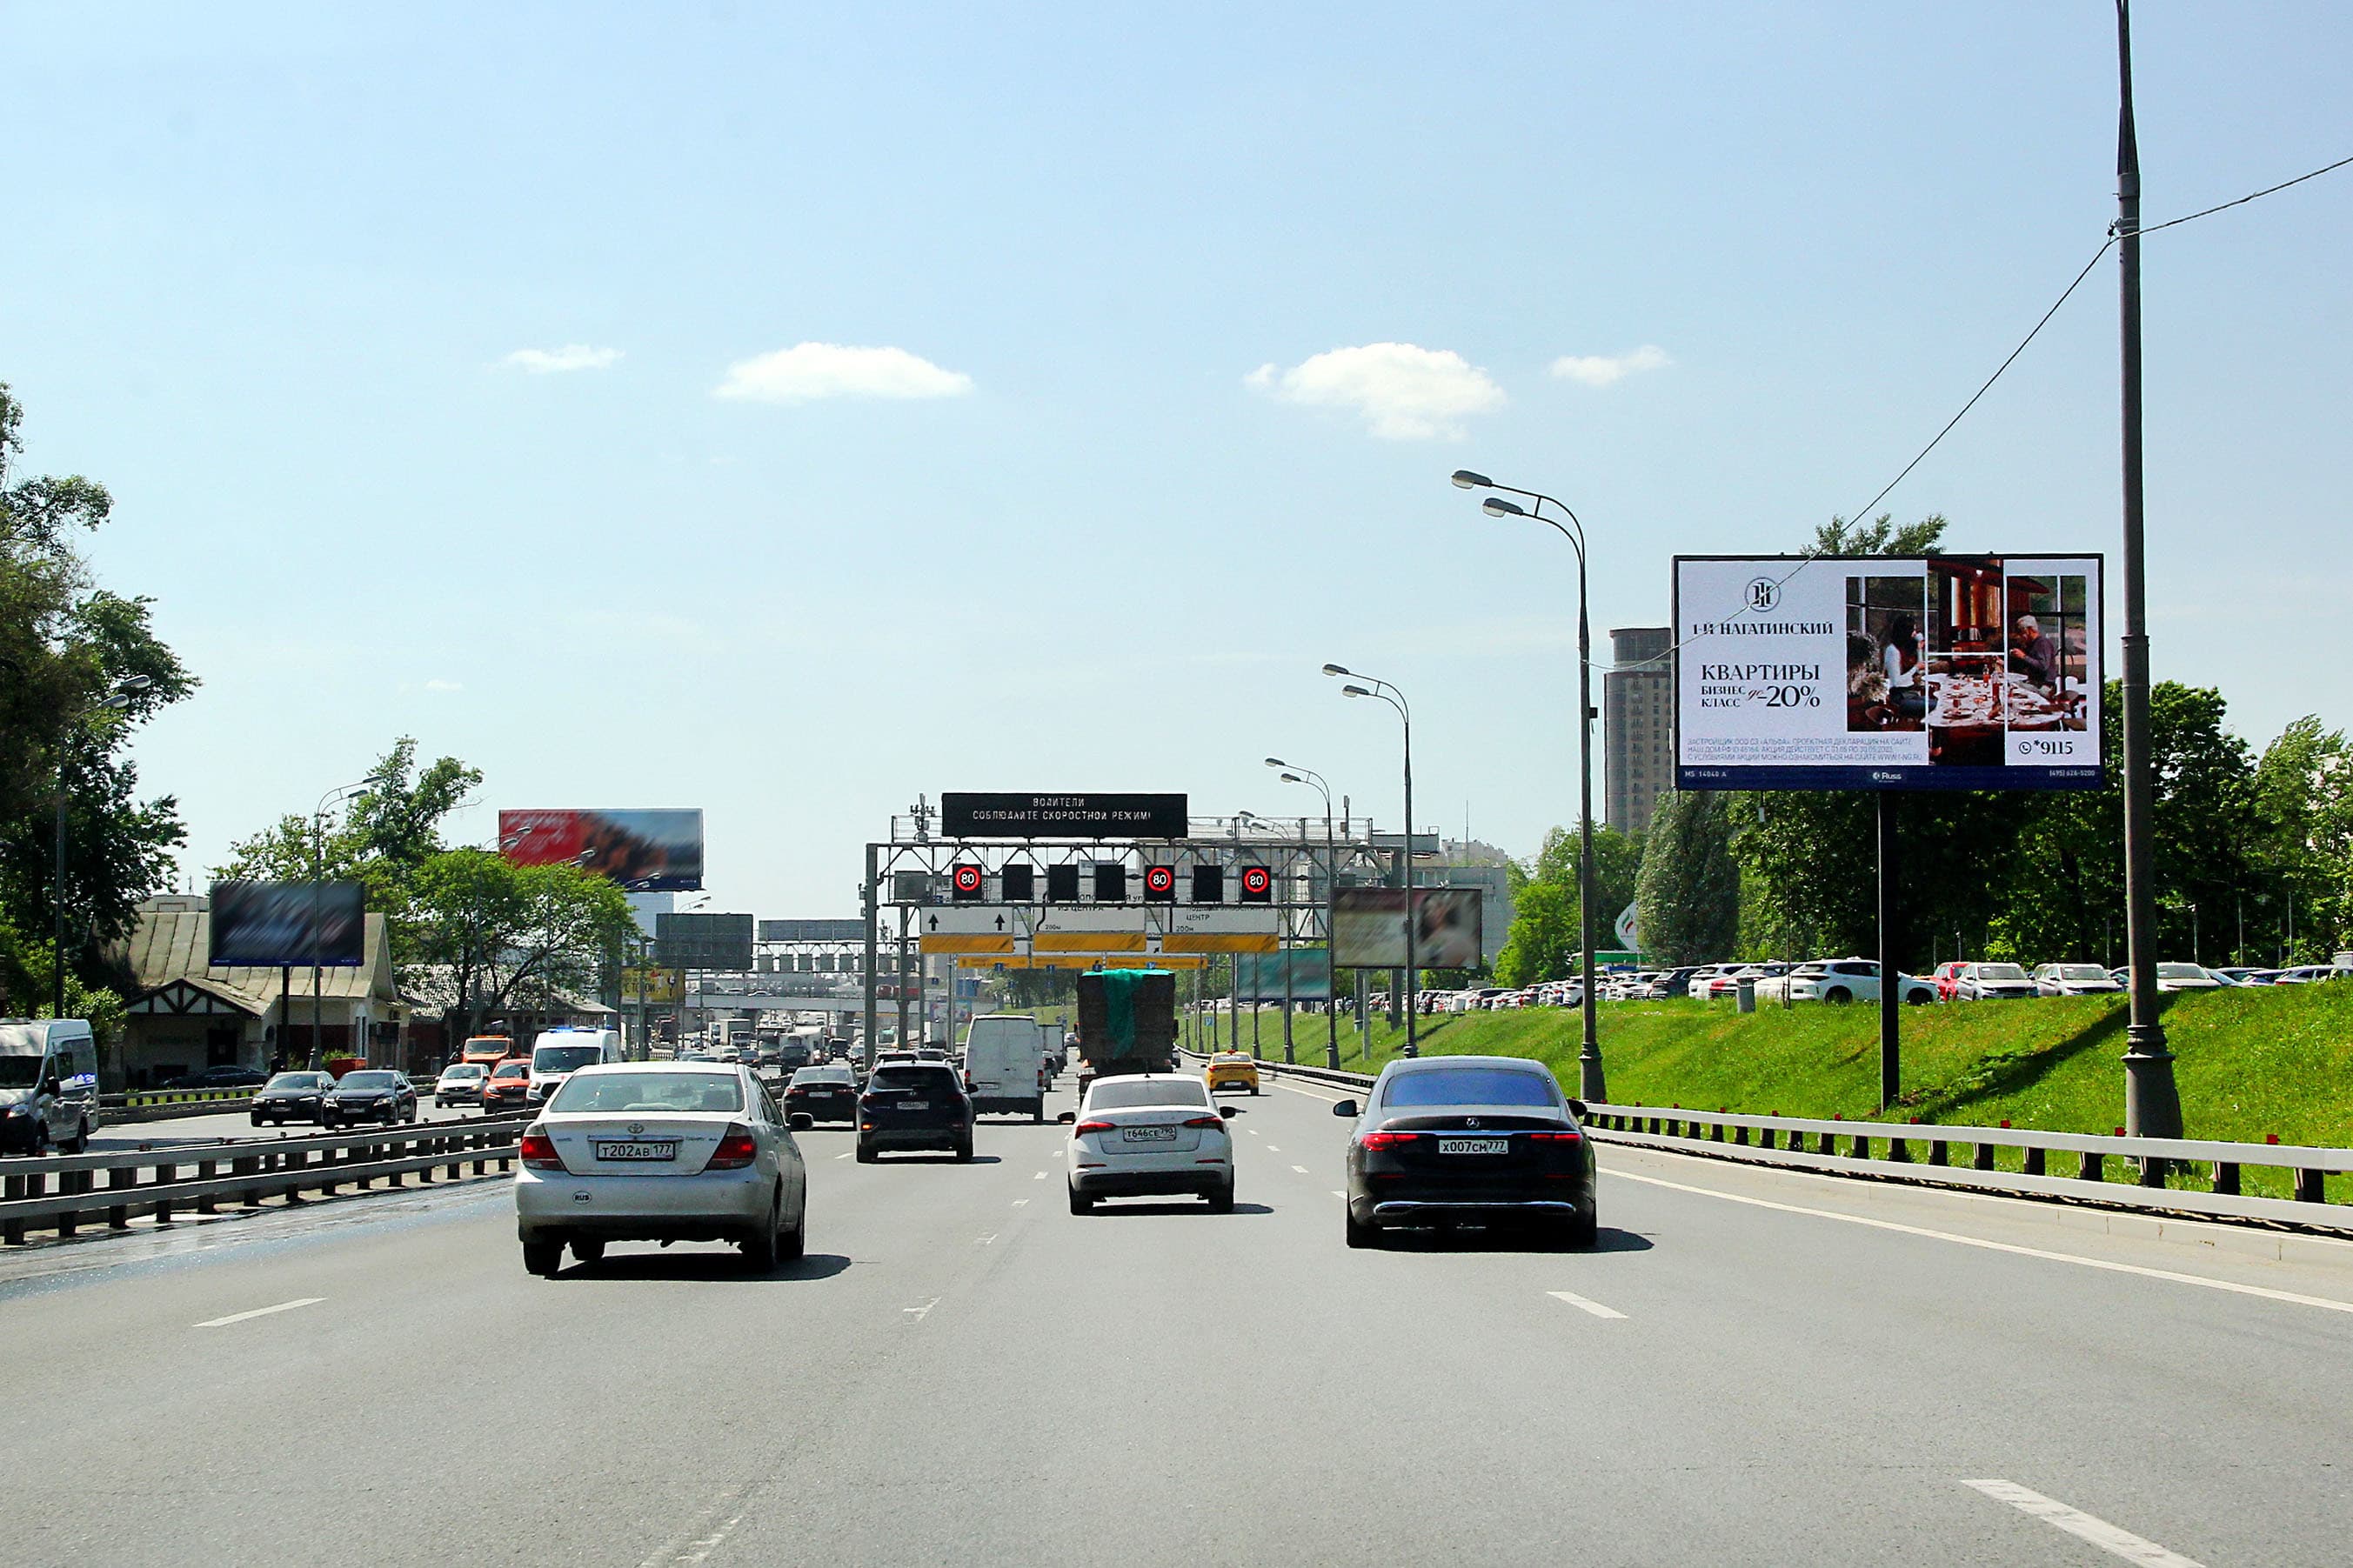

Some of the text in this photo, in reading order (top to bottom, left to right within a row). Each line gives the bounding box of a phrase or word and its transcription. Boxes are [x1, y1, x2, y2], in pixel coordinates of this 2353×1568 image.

[1720, 621, 1834, 635] НАГАТИНСКИЙ
[1701, 664, 1820, 680] КВАРТИРЫ
[1701, 685, 1746, 695] БИЗНЕС
[1701, 698, 1741, 708] КЛАСС
[1033, 797, 1085, 807] ВОДИТЕЛИ
[960, 873, 975, 884] 80
[1153, 874, 1167, 884] 80
[1249, 875, 1263, 885] 80
[653, 1144, 671, 1154] 177
